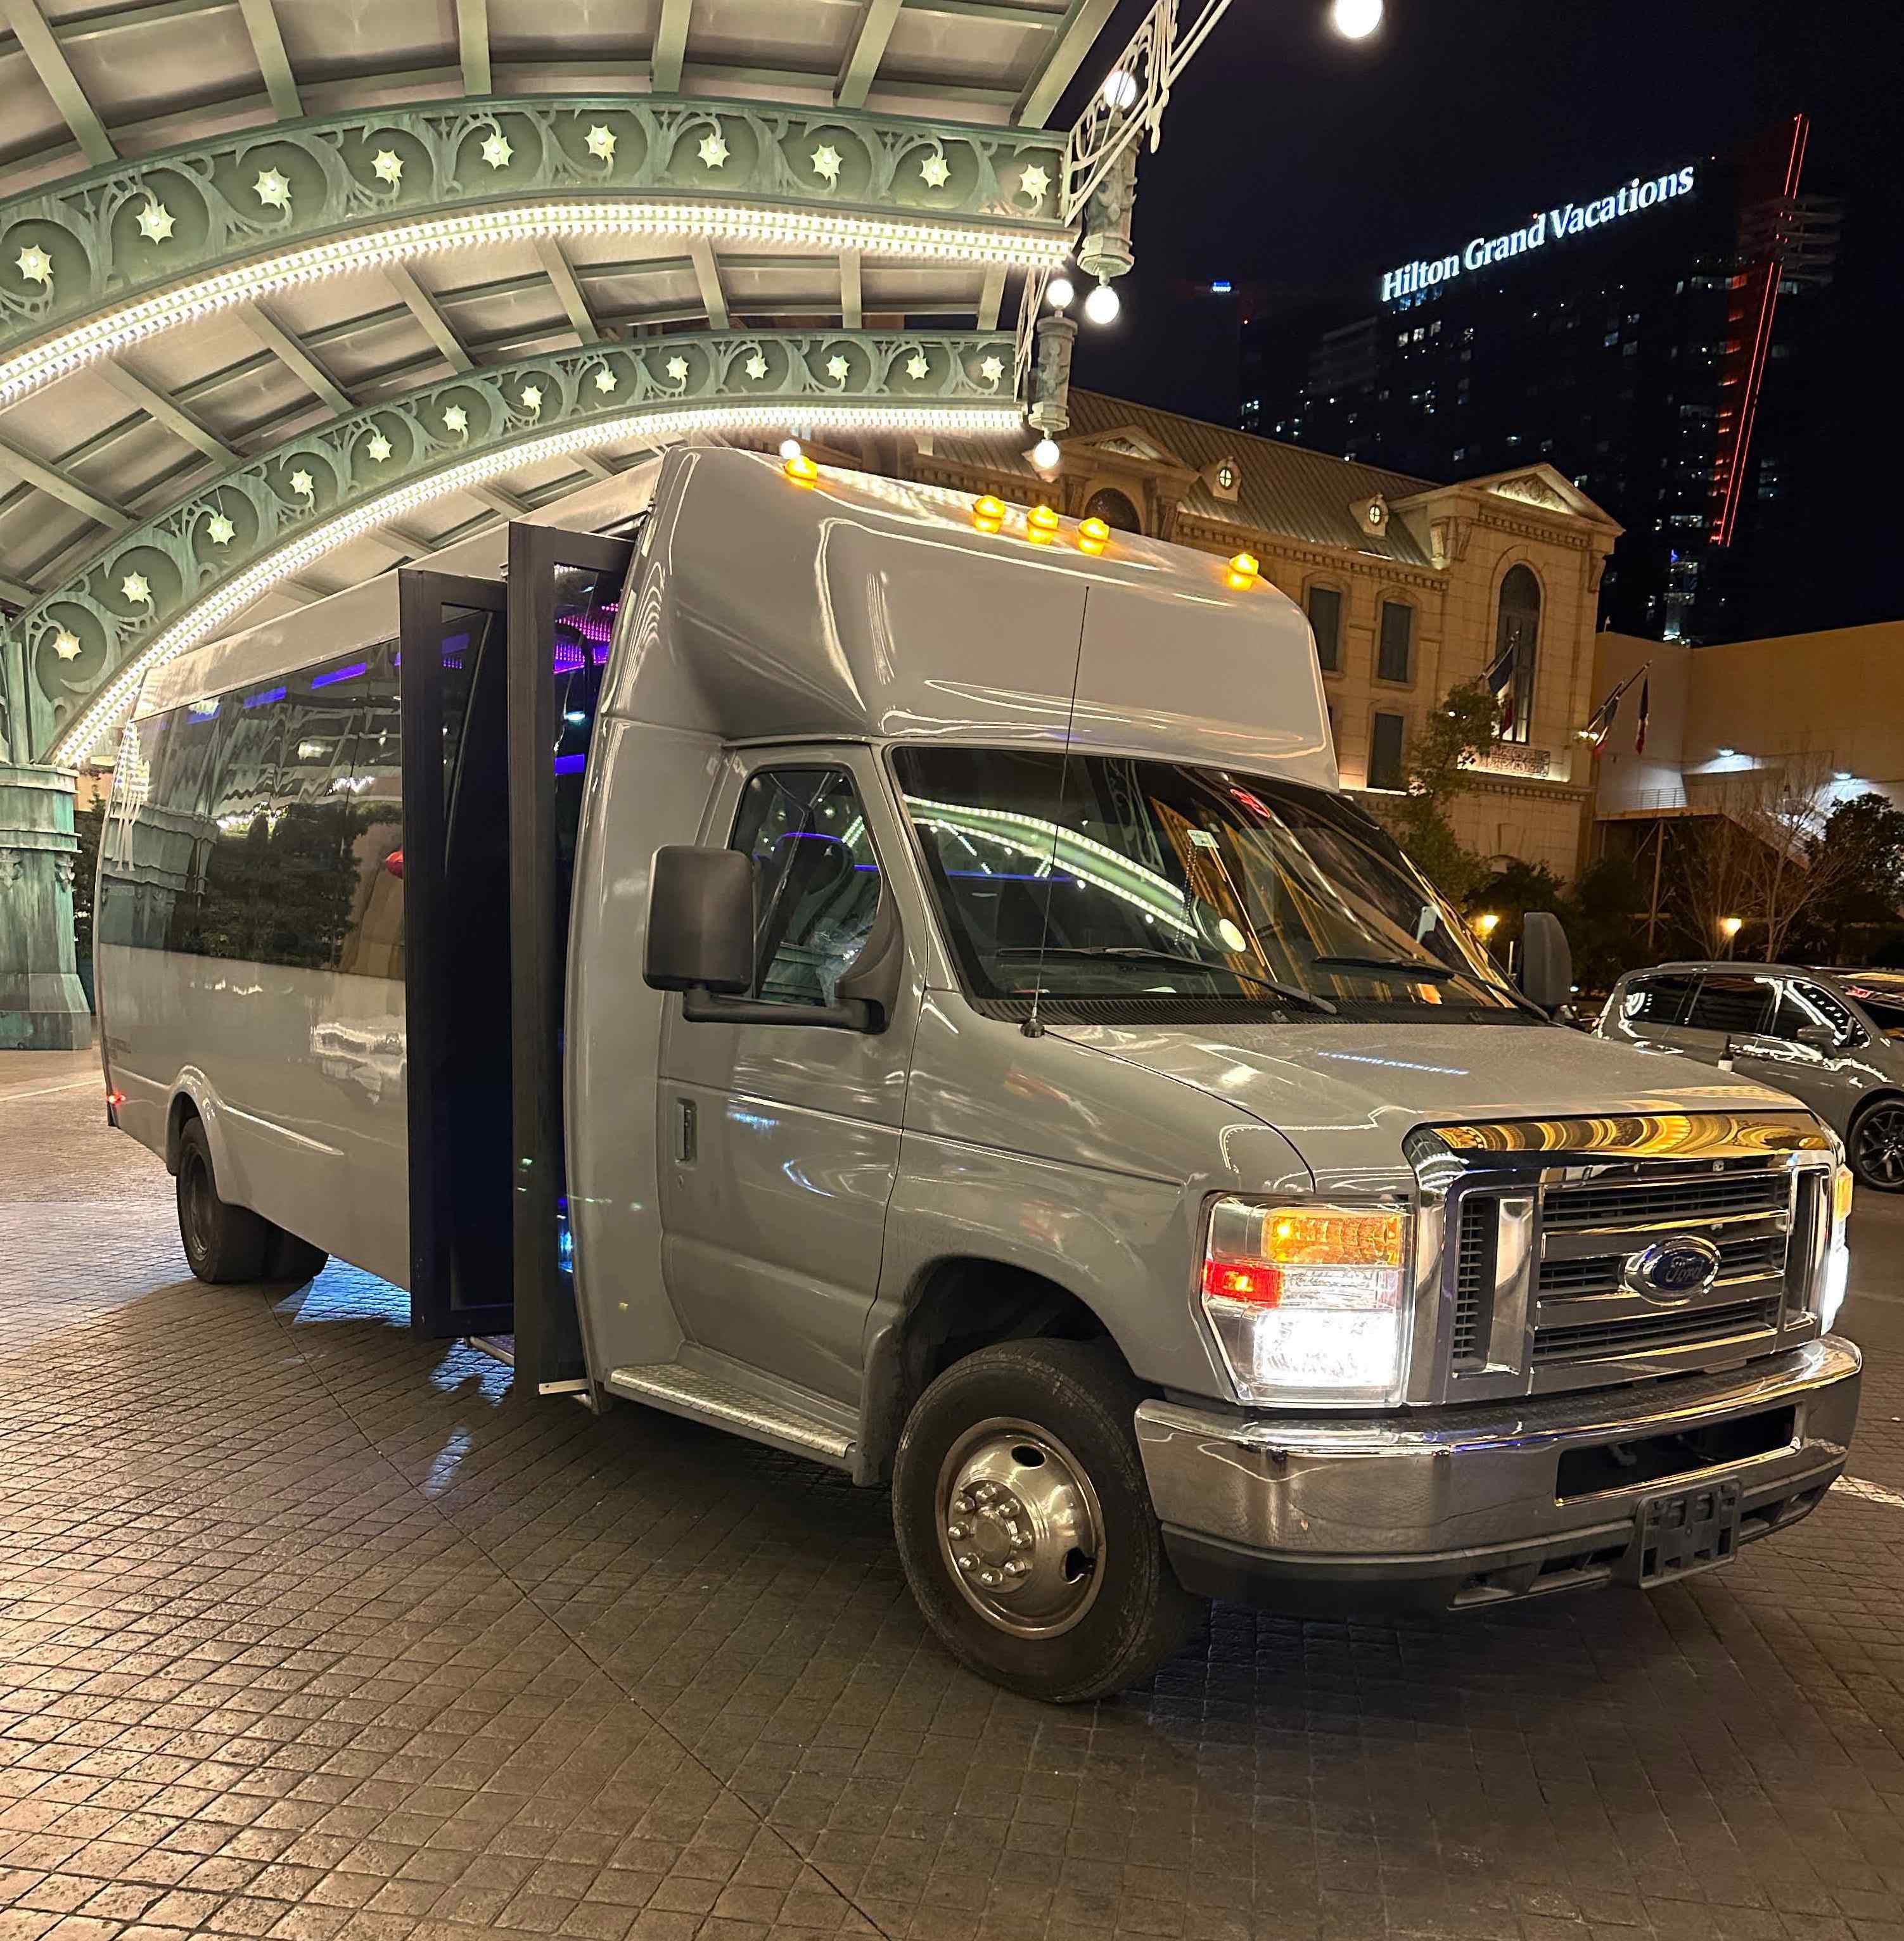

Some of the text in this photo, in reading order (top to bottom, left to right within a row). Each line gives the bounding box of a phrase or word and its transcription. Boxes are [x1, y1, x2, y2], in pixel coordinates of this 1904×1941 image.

[1381, 166, 1694, 302] Hilton Grand Vacations
[1666, 1256, 1705, 1283] Ford
